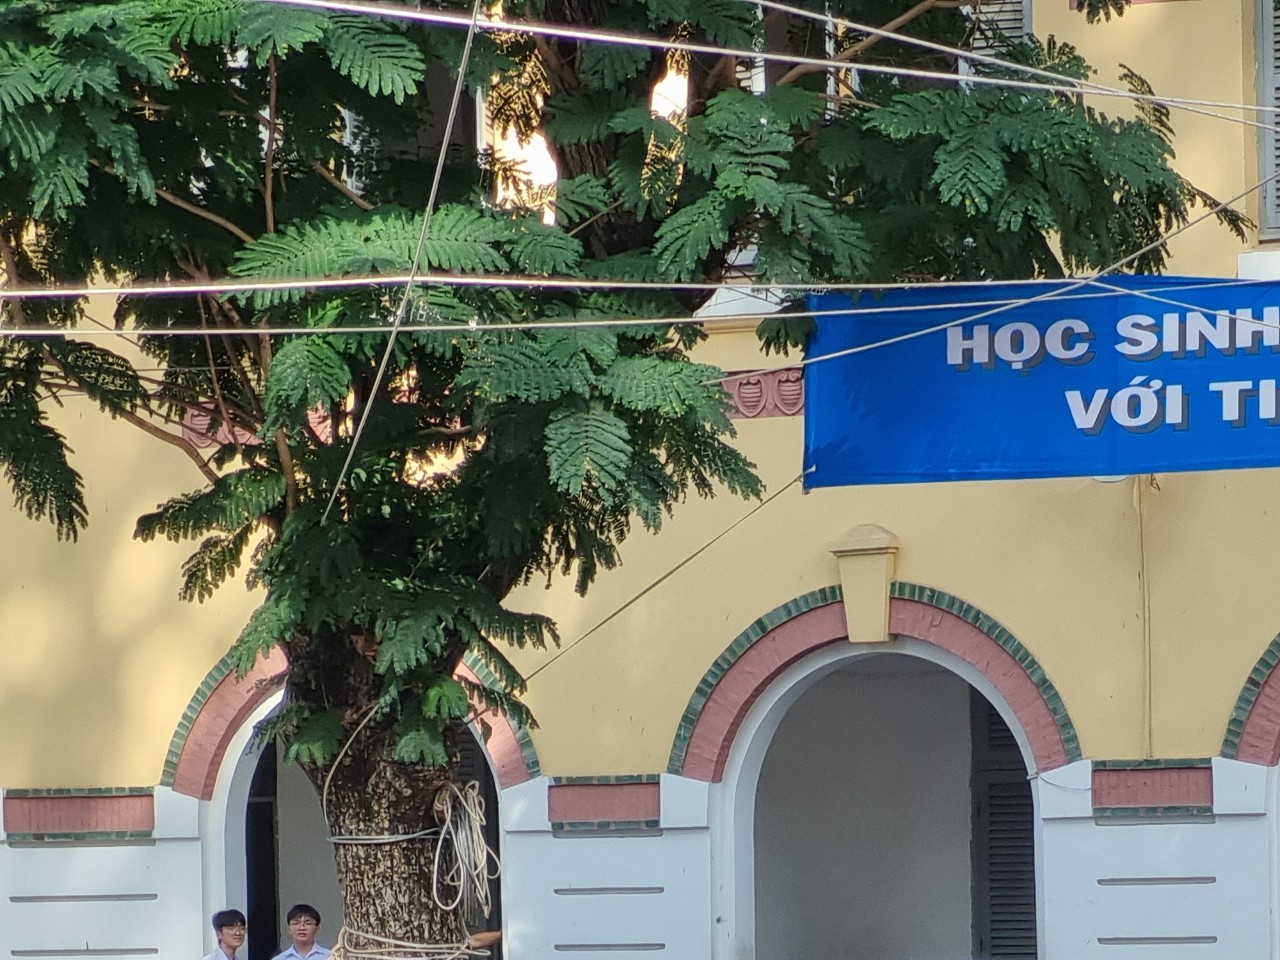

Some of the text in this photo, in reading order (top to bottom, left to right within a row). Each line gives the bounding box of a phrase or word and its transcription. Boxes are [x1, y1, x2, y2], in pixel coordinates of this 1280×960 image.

[946, 317, 1092, 370] HỌC
[1114, 306, 1280, 356] SINH
[1063, 375, 1184, 430] VỚI
